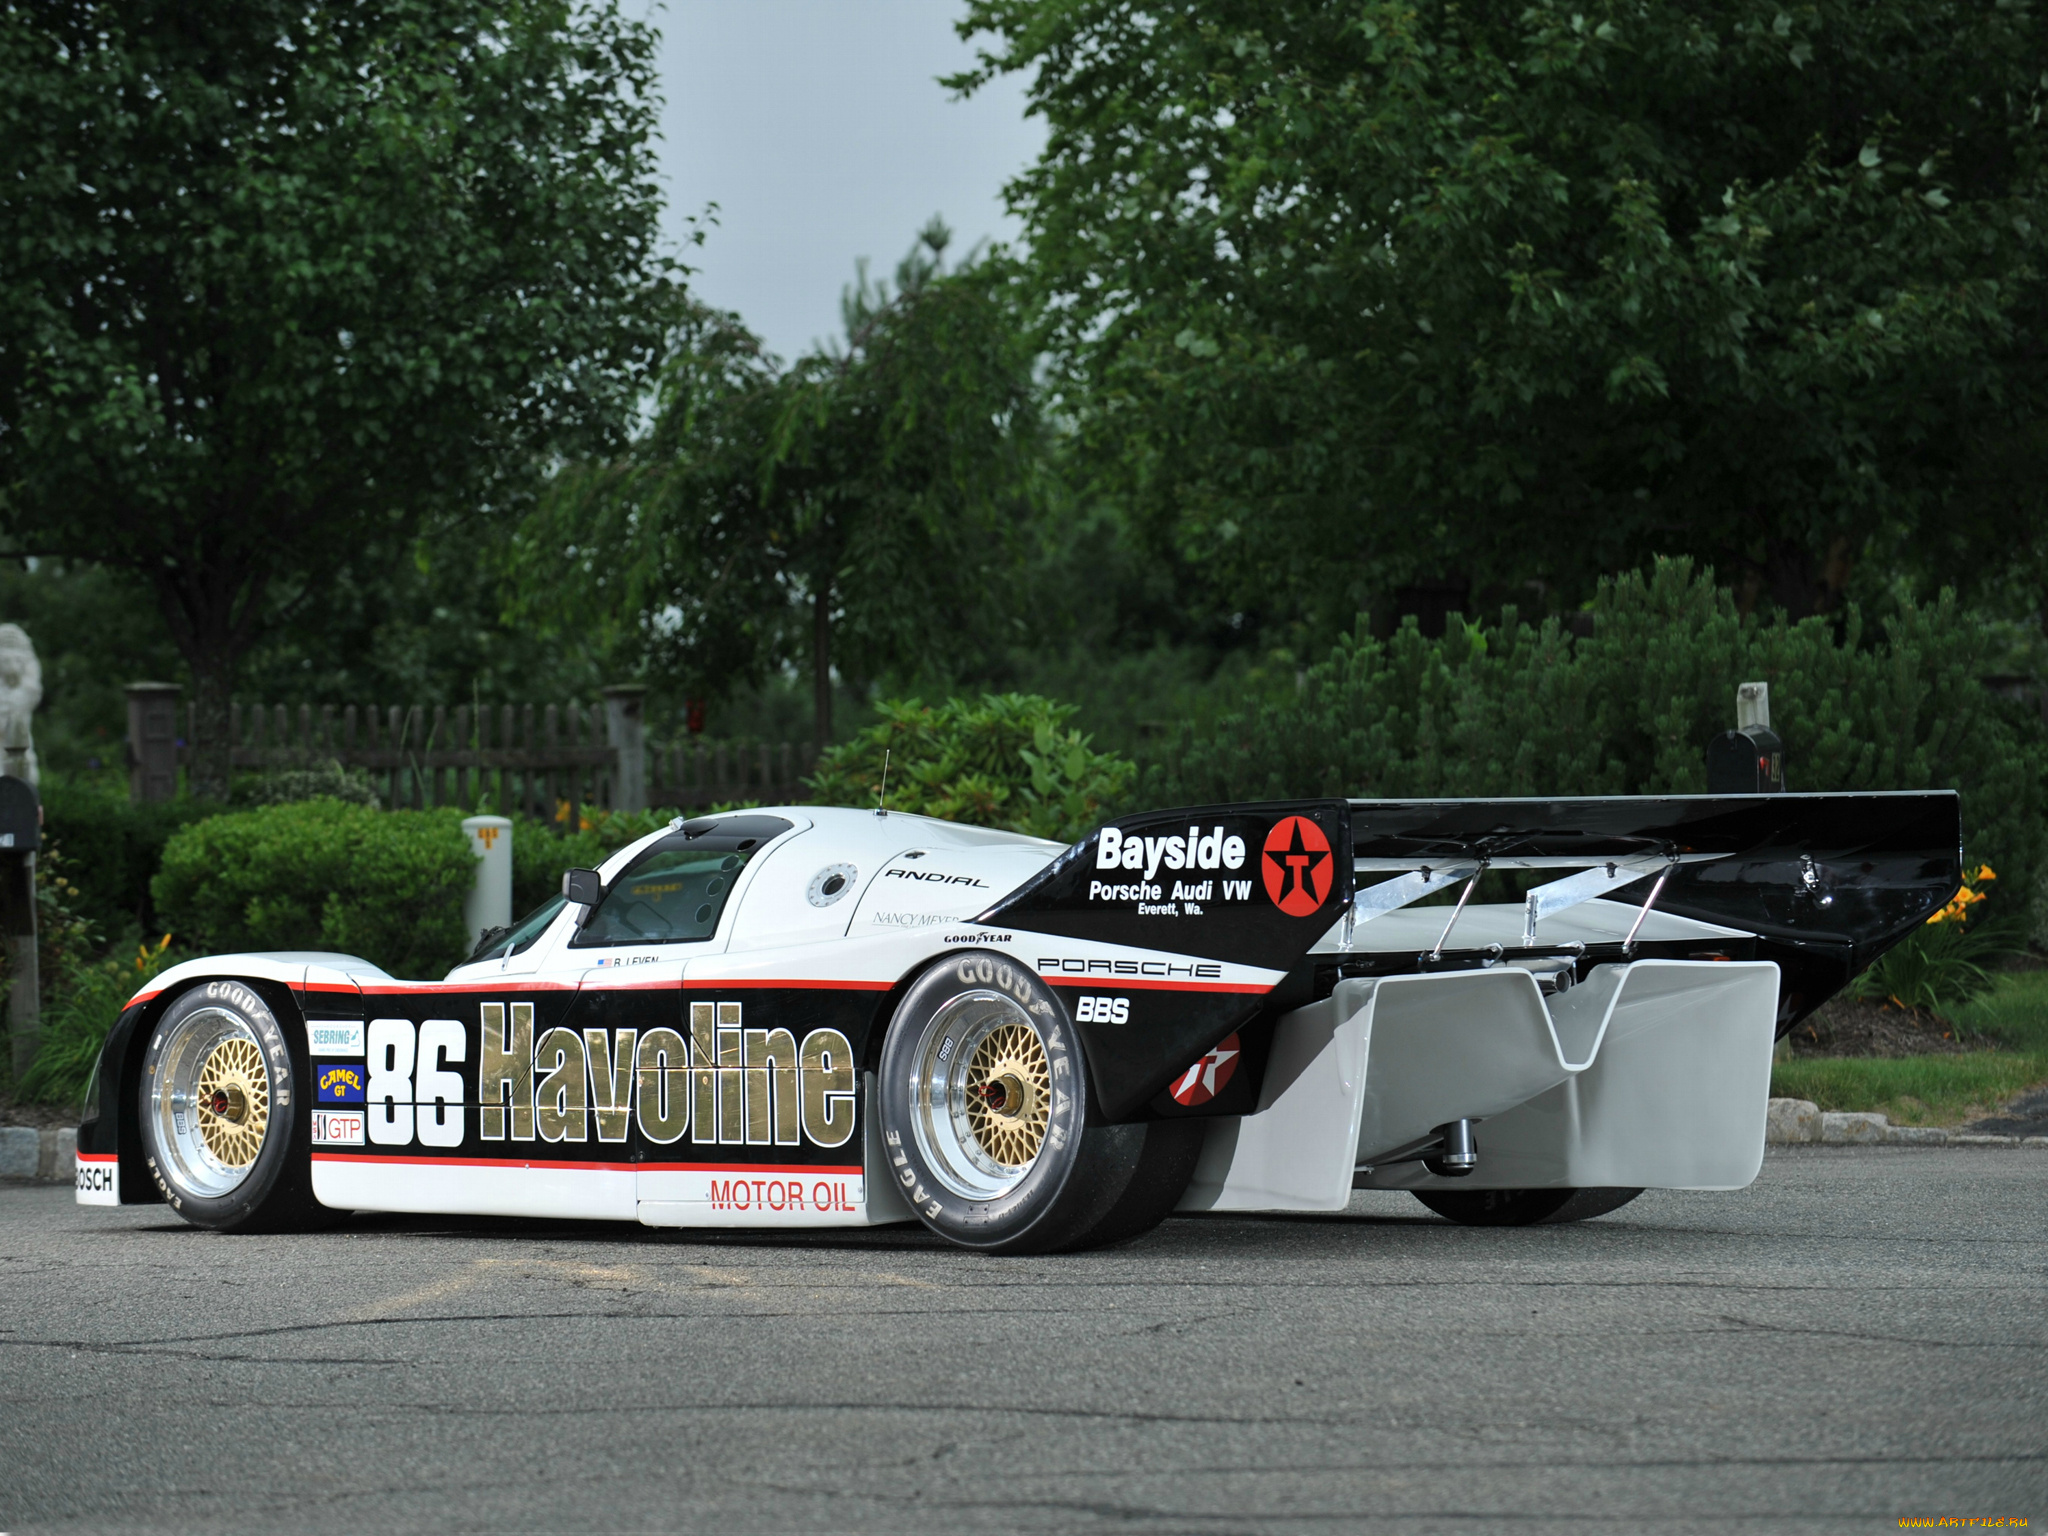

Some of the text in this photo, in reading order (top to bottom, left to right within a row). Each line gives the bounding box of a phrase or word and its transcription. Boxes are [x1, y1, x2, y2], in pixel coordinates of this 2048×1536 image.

[1096, 826, 1246, 881] Bayside
[885, 869, 990, 888] ANDIAL
[1089, 881, 1252, 900] Porsche Audi VW
[873, 912, 918, 926] NANCY
[1138, 903, 1204, 918] Everett, Wa.
[944, 932, 1012, 945] GOODYEAR
[1037, 958, 1222, 978] PORSCHE
[1076, 996, 1130, 1025] BBS
[313, 1029, 350, 1045] SEBRING
[938, 1036, 954, 1061] BBS
[320, 1068, 361, 1091] CAMEL
[366, 1019, 467, 1148] 86
[480, 1001, 857, 1148] Havoline
[334, 1084, 346, 1097] GT
[175, 1111, 187, 1135] BBS
[328, 1118, 361, 1139] GTP
[147, 1157, 182, 1210] EAGLE
[886, 1130, 944, 1220] EAGLE
[710, 1180, 856, 1212] MOTOR OIL
